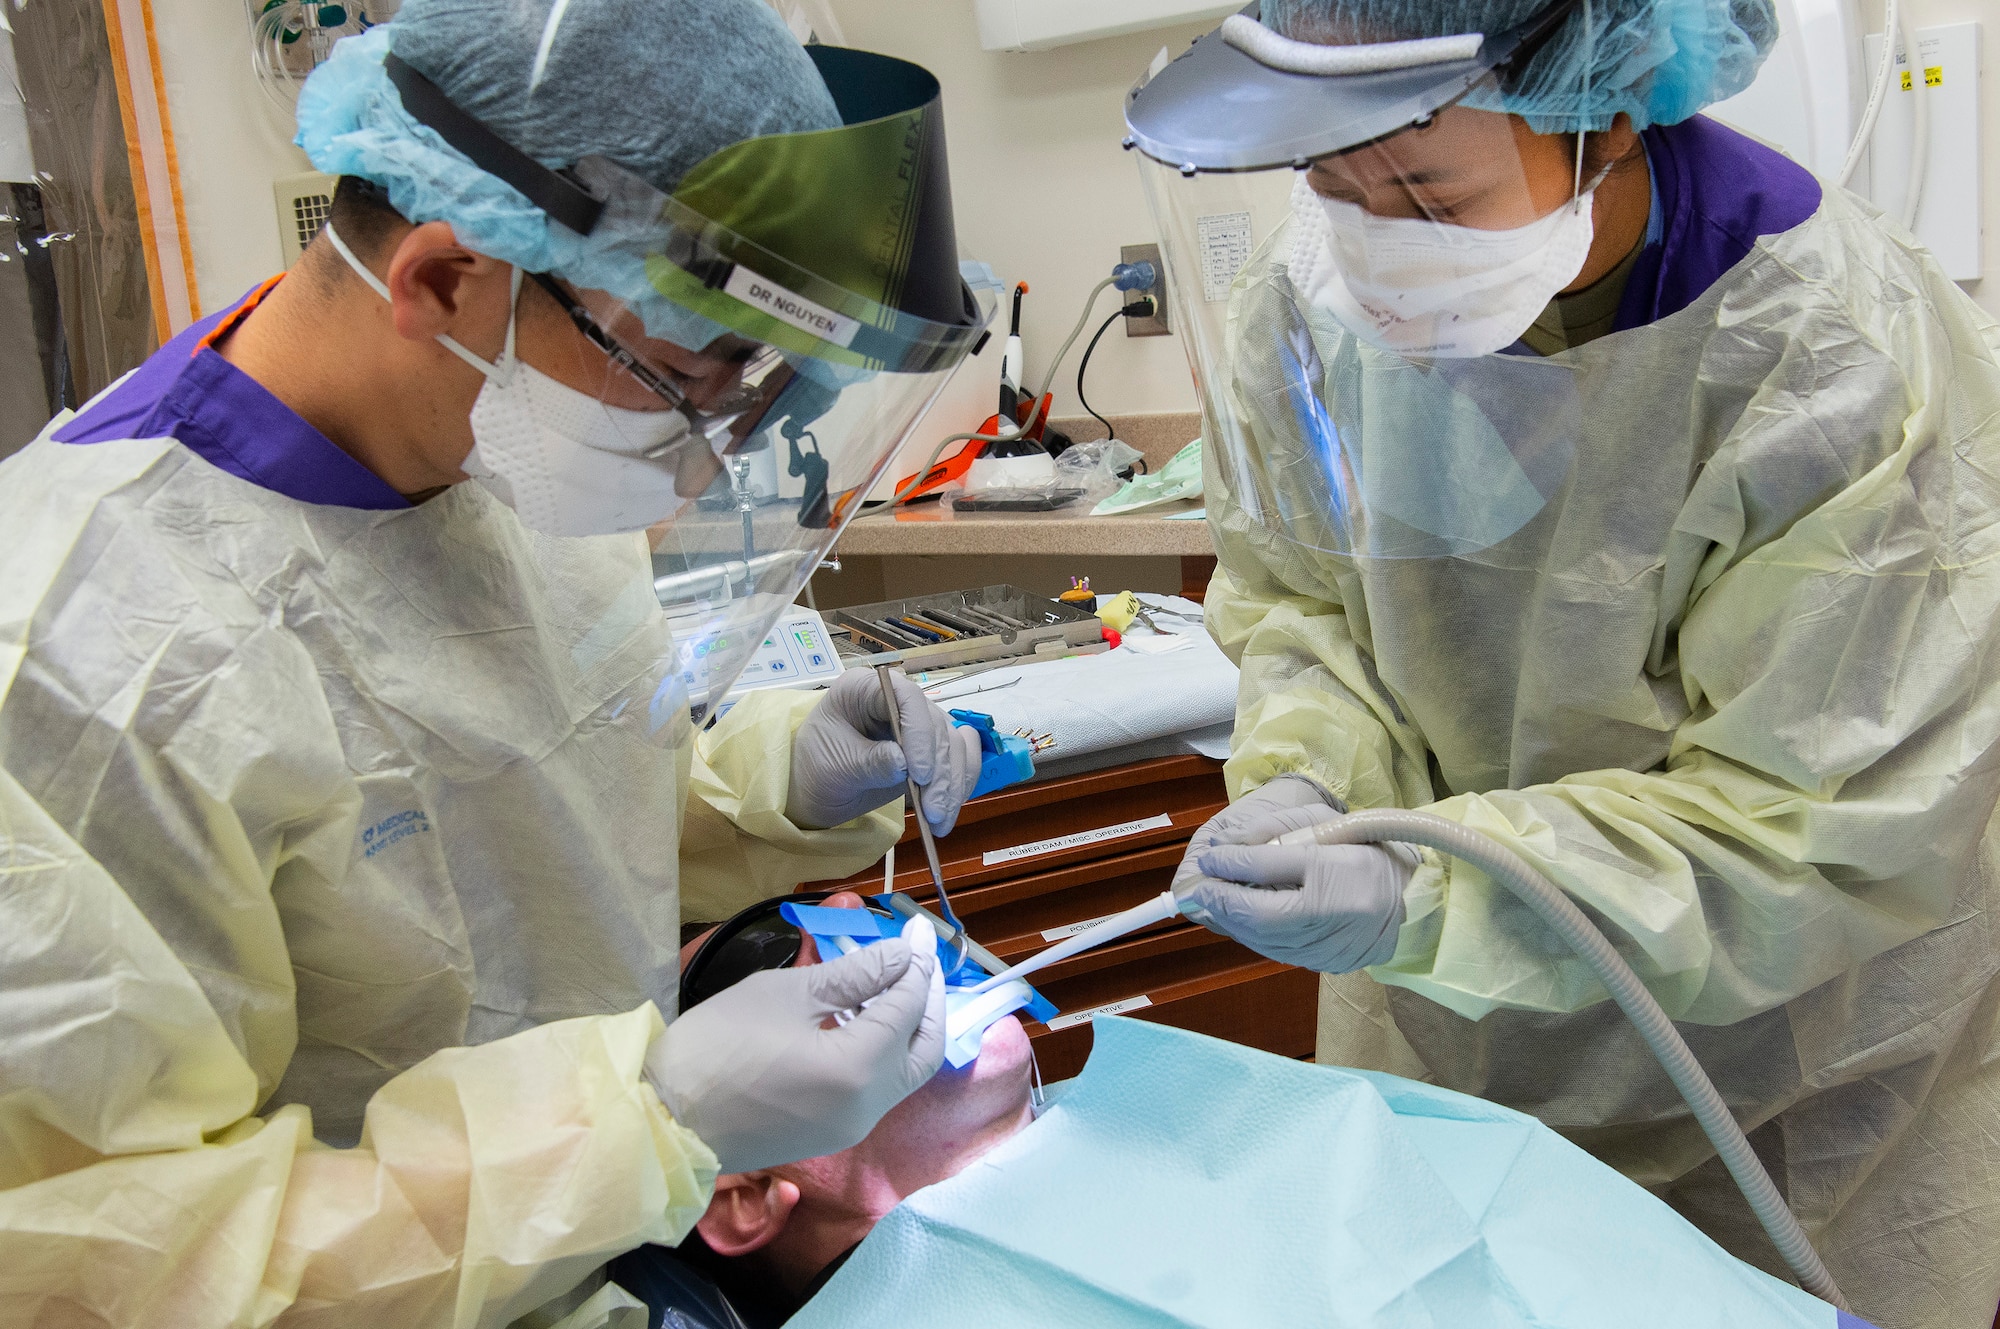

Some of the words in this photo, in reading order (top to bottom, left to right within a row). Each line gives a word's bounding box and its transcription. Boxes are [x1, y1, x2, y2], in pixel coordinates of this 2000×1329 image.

[749, 283, 772, 303] DR
[773, 295, 838, 333] NGUYEN
[1009, 845, 1041, 857] RUBER
[1042, 840, 1063, 851] DAM
[1069, 834, 1094, 845] MISC.
[1095, 823, 1145, 839] OPERATIVE
[1069, 917, 1113, 932] POLISHI
[1074, 1003, 1125, 1021] OPEATIVE
